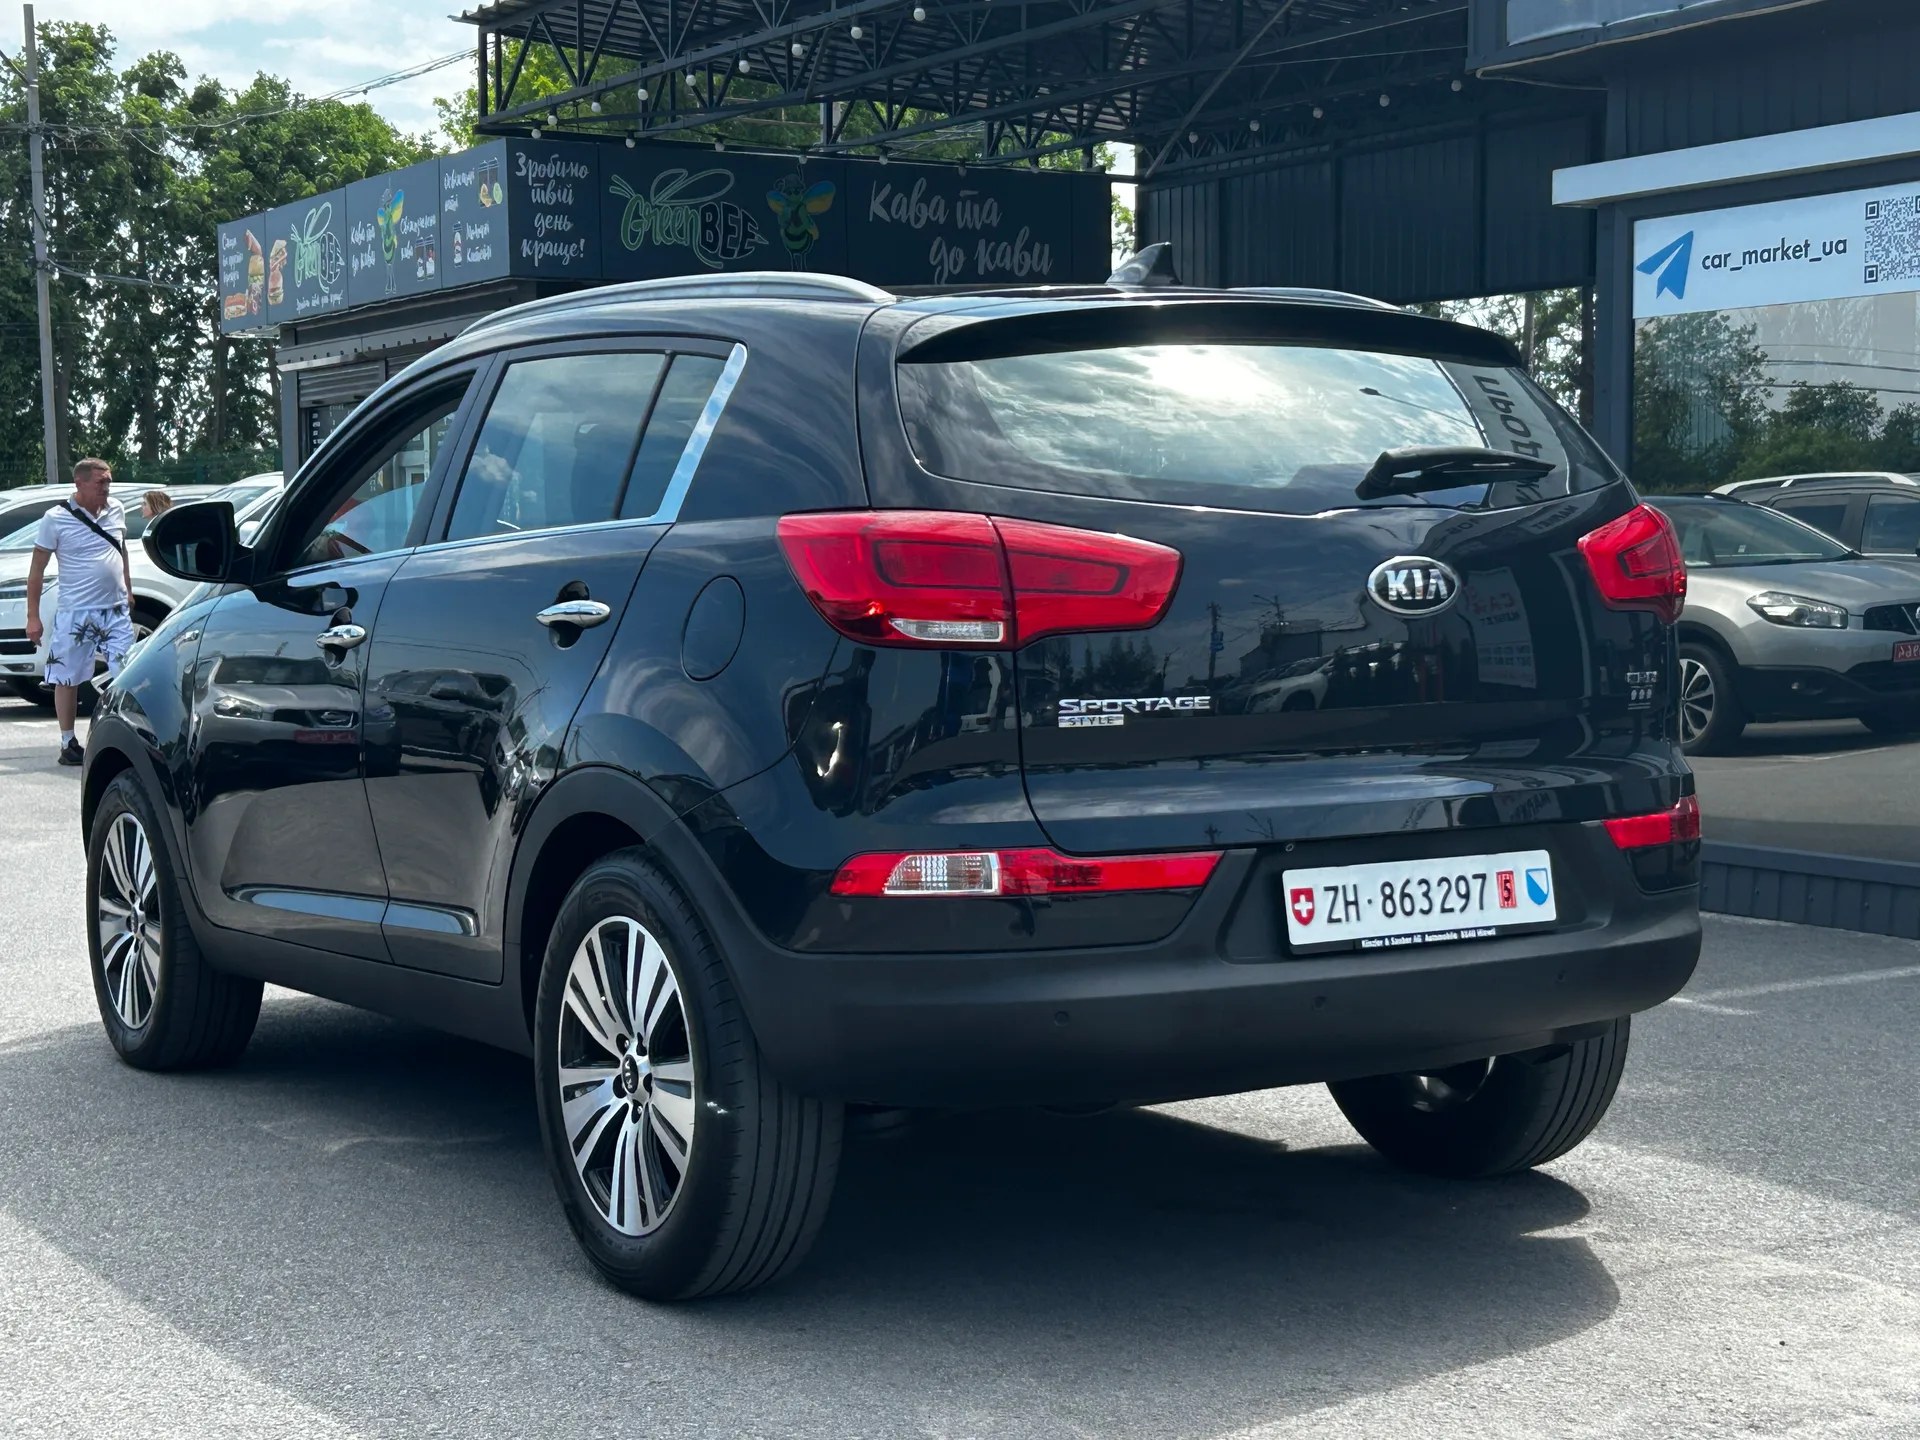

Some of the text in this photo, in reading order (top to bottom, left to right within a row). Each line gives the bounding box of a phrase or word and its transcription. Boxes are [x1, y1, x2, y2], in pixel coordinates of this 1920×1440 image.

[515, 152, 590, 185] Зробимо
[531, 179, 574, 206] твій
[869, 177, 1002, 230] Кава та
[534, 213, 573, 237] день
[521, 238, 586, 267] краще!
[928, 226, 1053, 285] до кави
[1701, 237, 1848, 272] car_market_ua
[1385, 568, 1448, 600] KIA
[1058, 696, 1211, 714] SPORTAGE
[1069, 715, 1115, 726] STYLE
[1323, 883, 1361, 924] ZH
[1380, 873, 1488, 919] 863297
